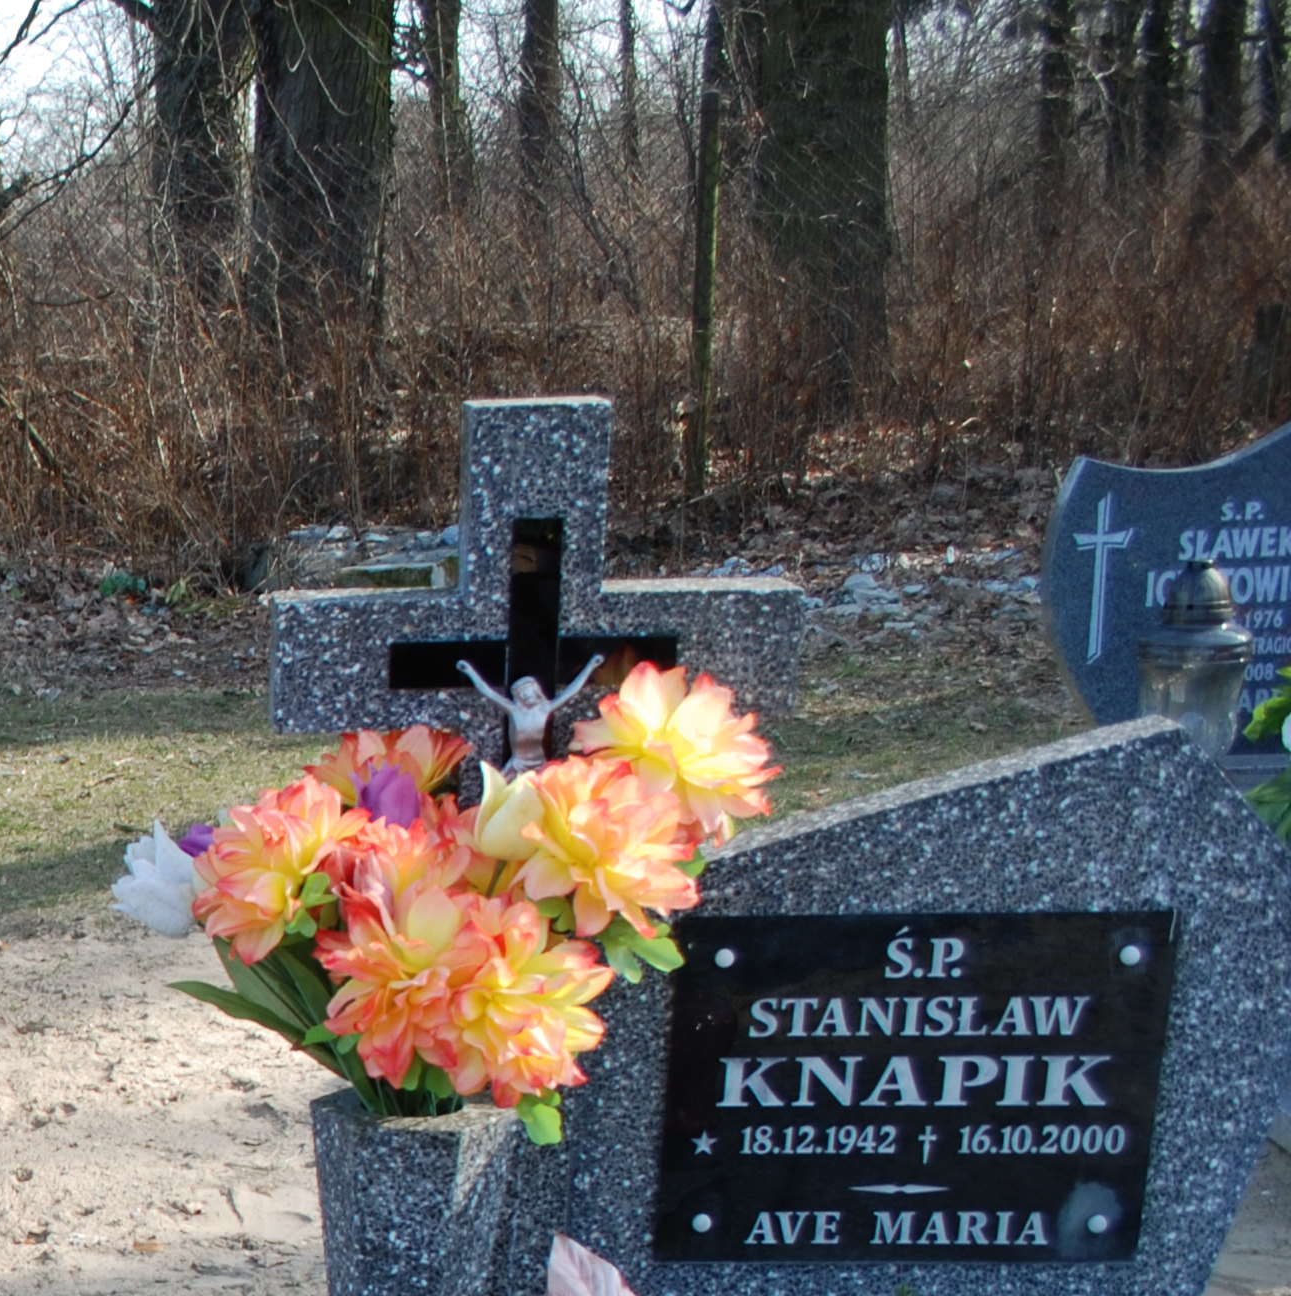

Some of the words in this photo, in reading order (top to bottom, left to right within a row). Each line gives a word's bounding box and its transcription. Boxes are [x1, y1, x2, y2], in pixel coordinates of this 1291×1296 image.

[884, 926, 966, 980] Ś.P.
[748, 995, 1091, 1039] STANISŁAW
[715, 1054, 1112, 1109] KNAPIK
[738, 1123, 897, 1157] 18.12.1942
[957, 1122, 1127, 1156] 16.10.2000
[743, 1210, 841, 1246] AVE
[869, 1210, 1050, 1246] MARIA
